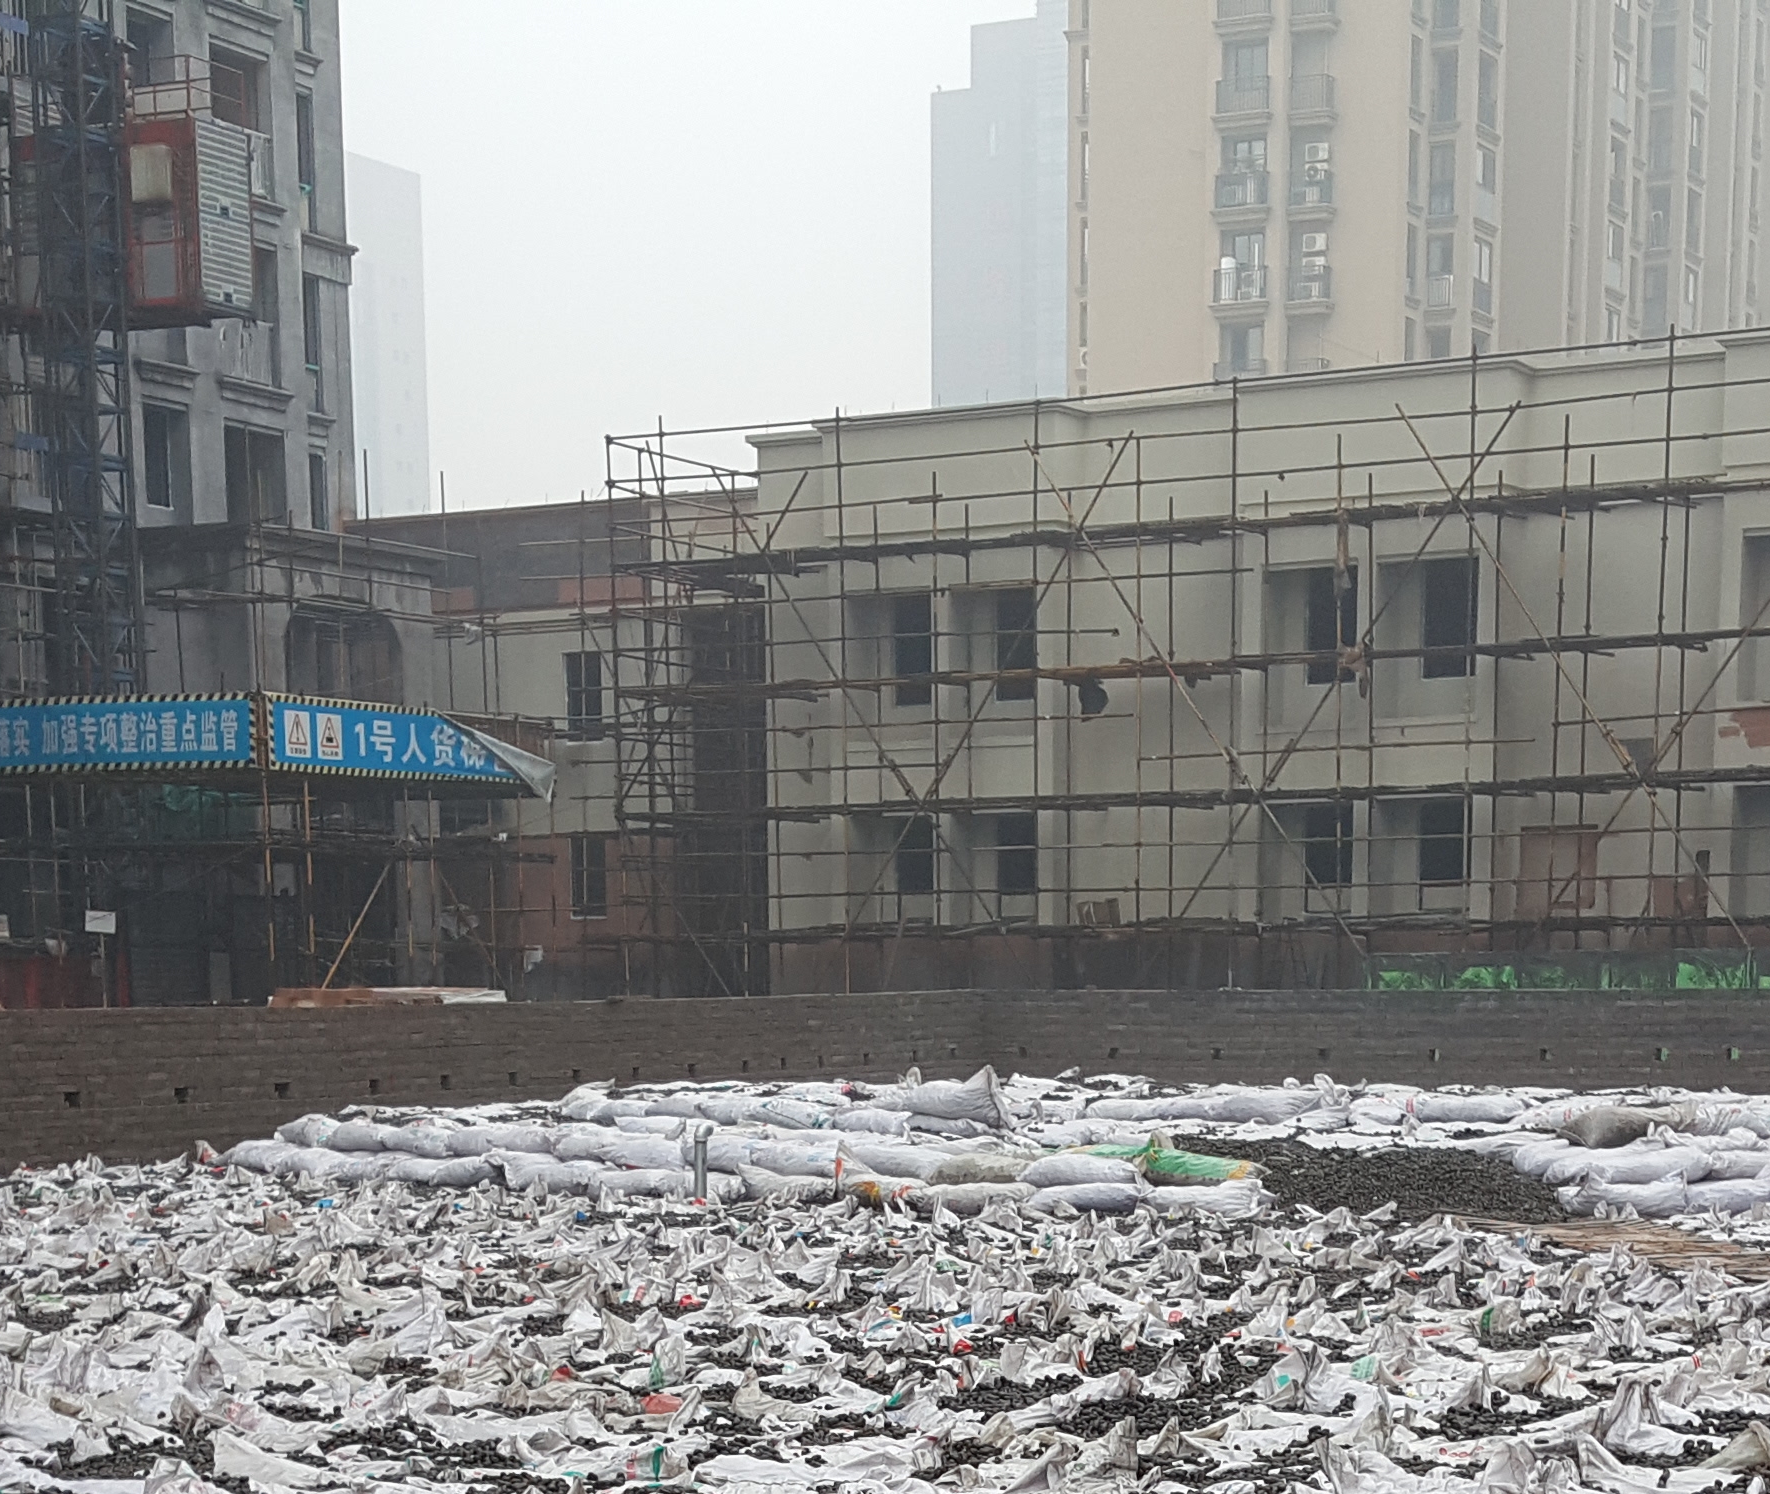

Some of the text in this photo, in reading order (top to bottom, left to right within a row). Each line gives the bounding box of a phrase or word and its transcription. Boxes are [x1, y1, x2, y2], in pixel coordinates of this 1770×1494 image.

[41, 708, 239, 755] 加强专项整治重点监管
[354, 719, 513, 772] 1号人货梯
